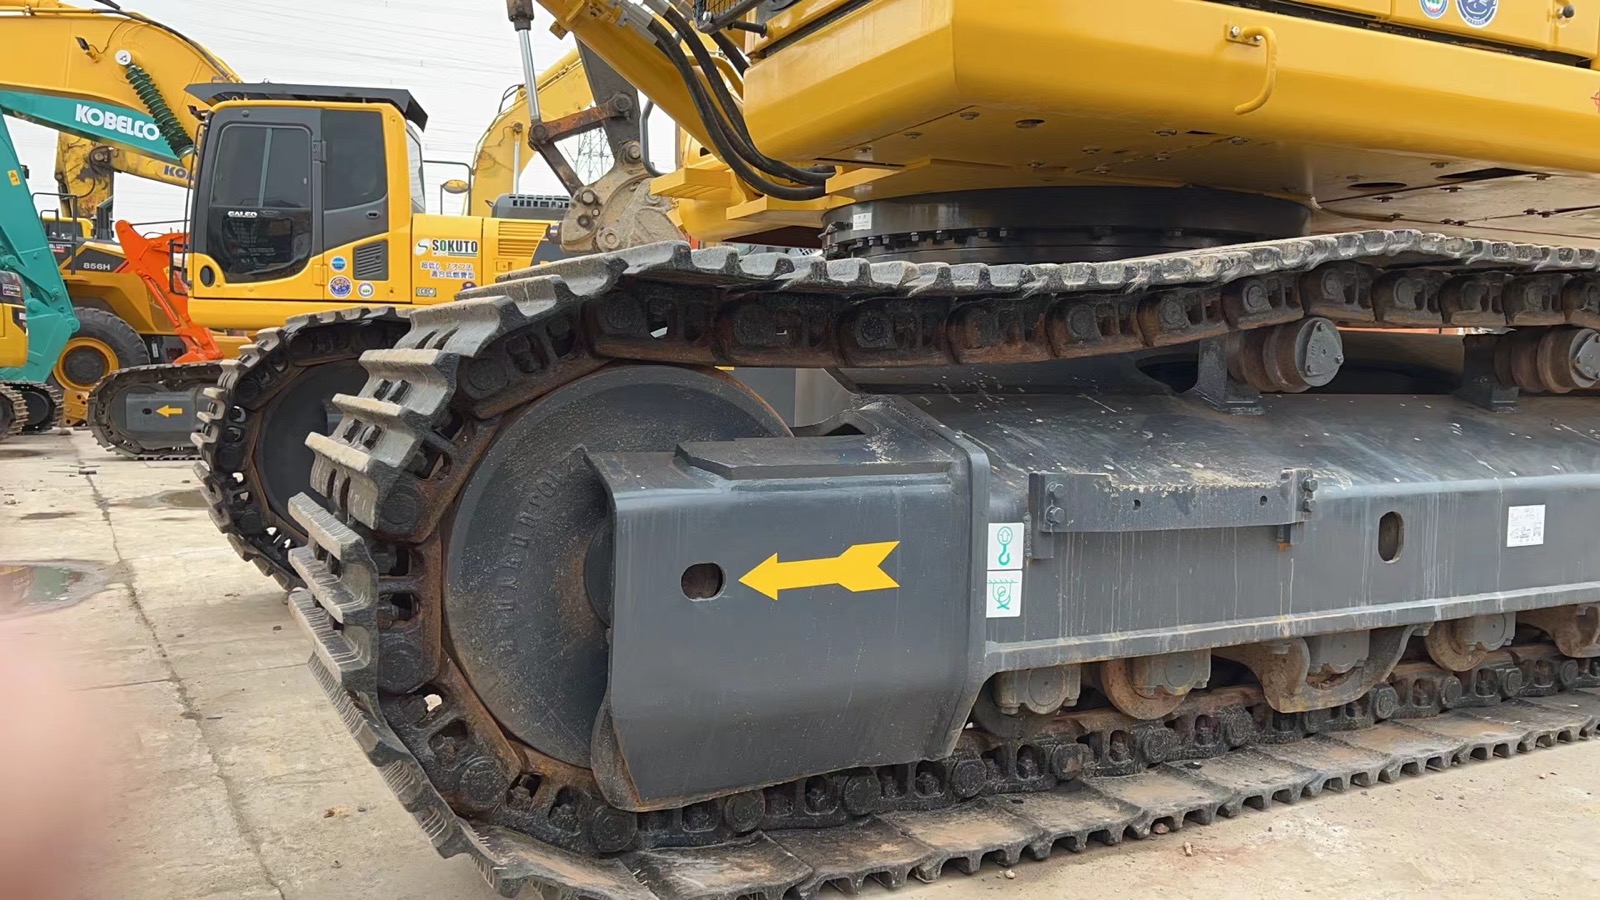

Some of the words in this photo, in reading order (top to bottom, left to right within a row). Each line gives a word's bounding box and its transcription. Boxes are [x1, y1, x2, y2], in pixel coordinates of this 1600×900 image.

[75, 103, 160, 140] KOBELCO
[432, 239, 478, 253] SOKUTO
[83, 262, 111, 270] 856H
